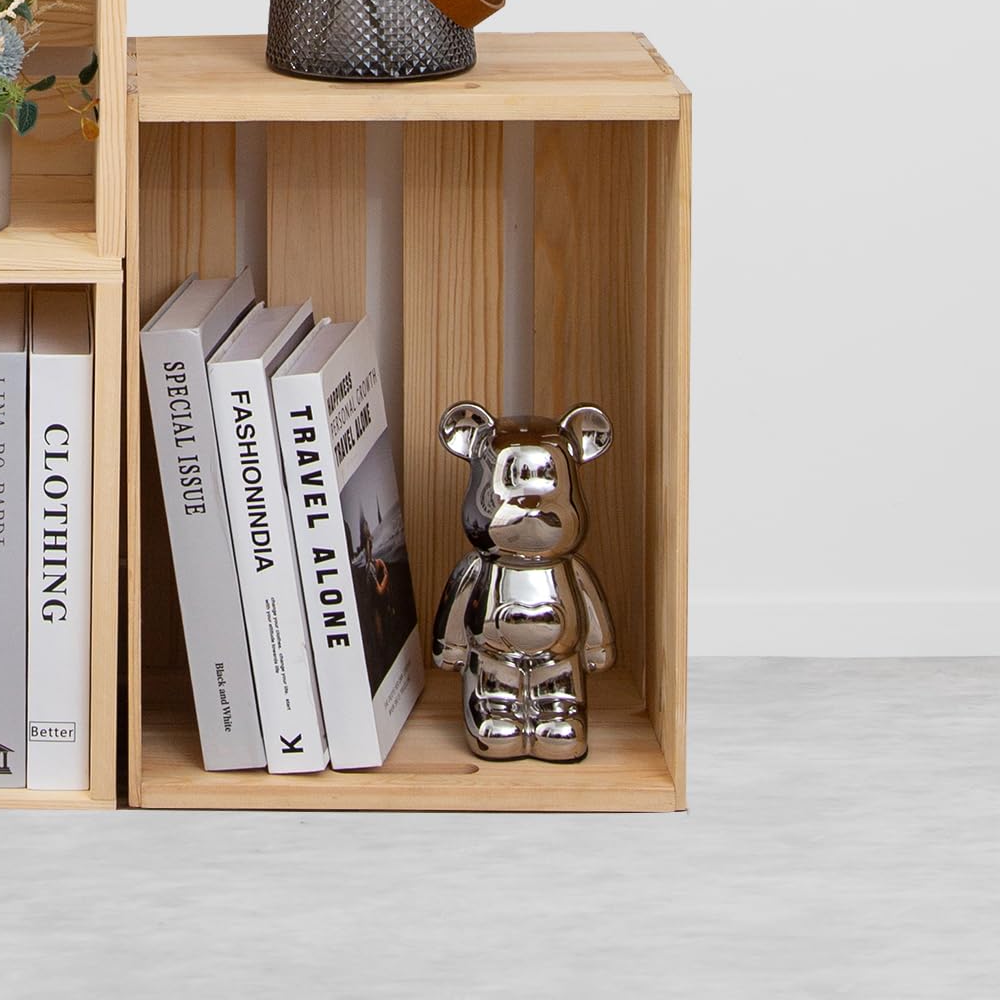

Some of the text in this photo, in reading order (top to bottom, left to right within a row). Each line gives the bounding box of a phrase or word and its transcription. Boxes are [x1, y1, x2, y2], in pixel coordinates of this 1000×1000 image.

[327, 371, 353, 416] HAPPINESS
[330, 394, 357, 440] PERSONAL
[163, 361, 206, 516] SPECIAL ISSUE
[334, 402, 372, 467] TRAVEL ALONE
[230, 390, 274, 573] FASHIONINDIA
[41, 423, 70, 624] CLOTHING
[290, 405, 350, 649] TRAVEL ALONE
[215, 662, 233, 733] Black and White
[31, 726, 74, 738] Better
[280, 734, 304, 755] K
